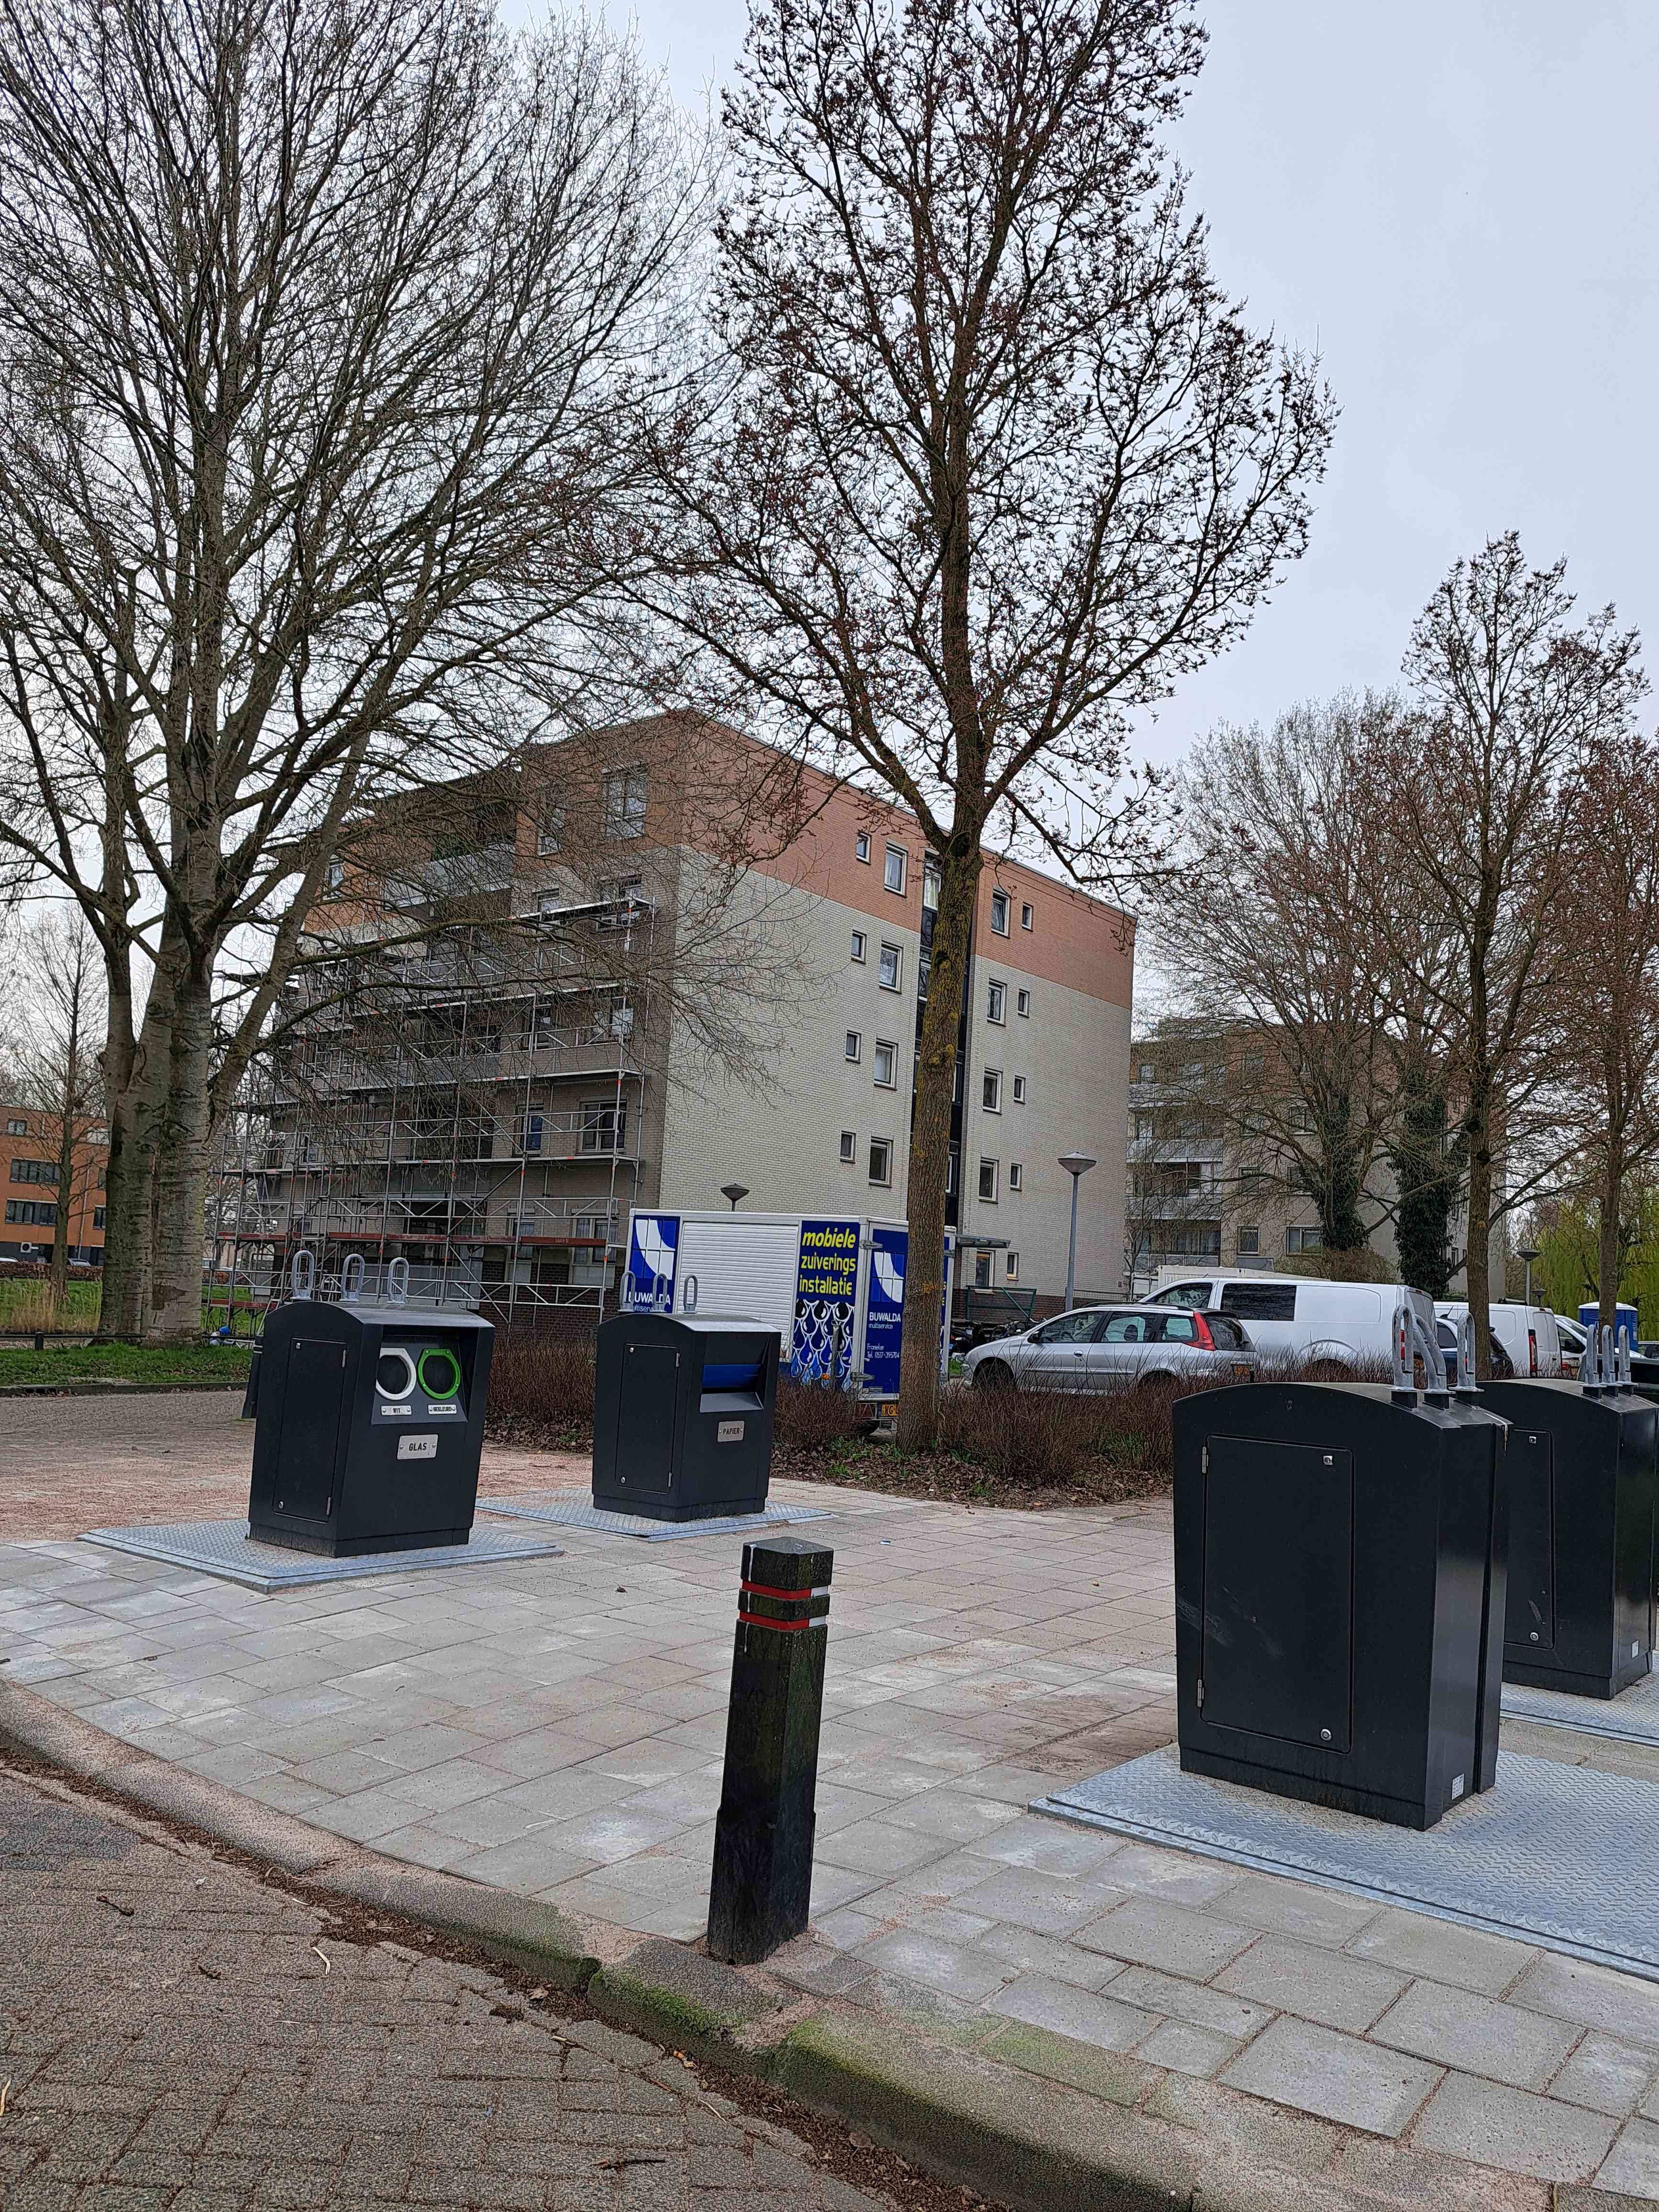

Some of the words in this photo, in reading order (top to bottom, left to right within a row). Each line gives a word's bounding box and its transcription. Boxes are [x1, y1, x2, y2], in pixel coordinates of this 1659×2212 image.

[802, 1228, 856, 1248] mobiele
[801, 1252, 856, 1275] zuiverings
[799, 1274, 852, 1295] installatie
[628, 1291, 671, 1305] UWADA
[869, 1312, 901, 1322] BUWALDA
[409, 1442, 427, 1451] GLAS
